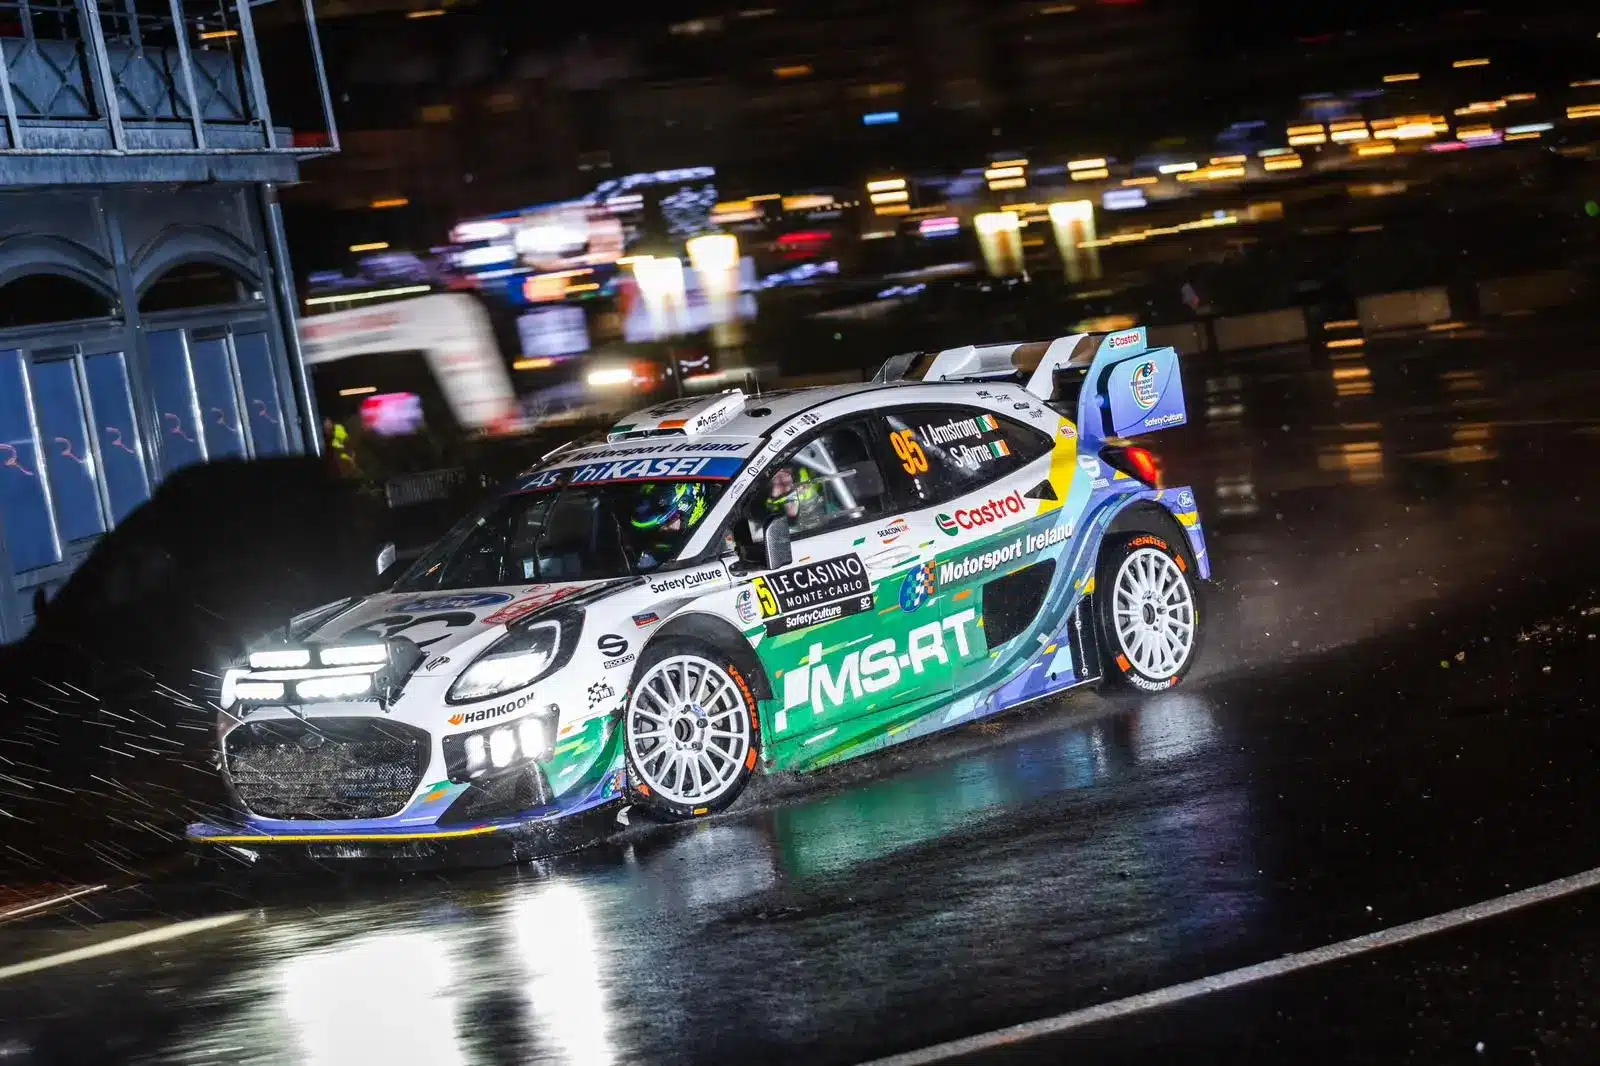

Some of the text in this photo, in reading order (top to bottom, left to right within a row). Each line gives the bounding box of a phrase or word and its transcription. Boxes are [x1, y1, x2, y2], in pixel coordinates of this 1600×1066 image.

[1115, 333, 1139, 346] Castrol
[919, 419, 982, 447] J Armstrong
[1145, 413, 1183, 427] SafetyCulture
[674, 443, 749, 458] Ireland
[889, 429, 929, 475] 95
[950, 443, 992, 471] S Byrne
[954, 490, 1026, 530] Castrol
[940, 522, 1073, 585] Motorsport Ireland
[651, 567, 722, 594] SafetyCulture
[771, 558, 861, 594] LE CASINO
[786, 605, 841, 628] SafetyCulture
